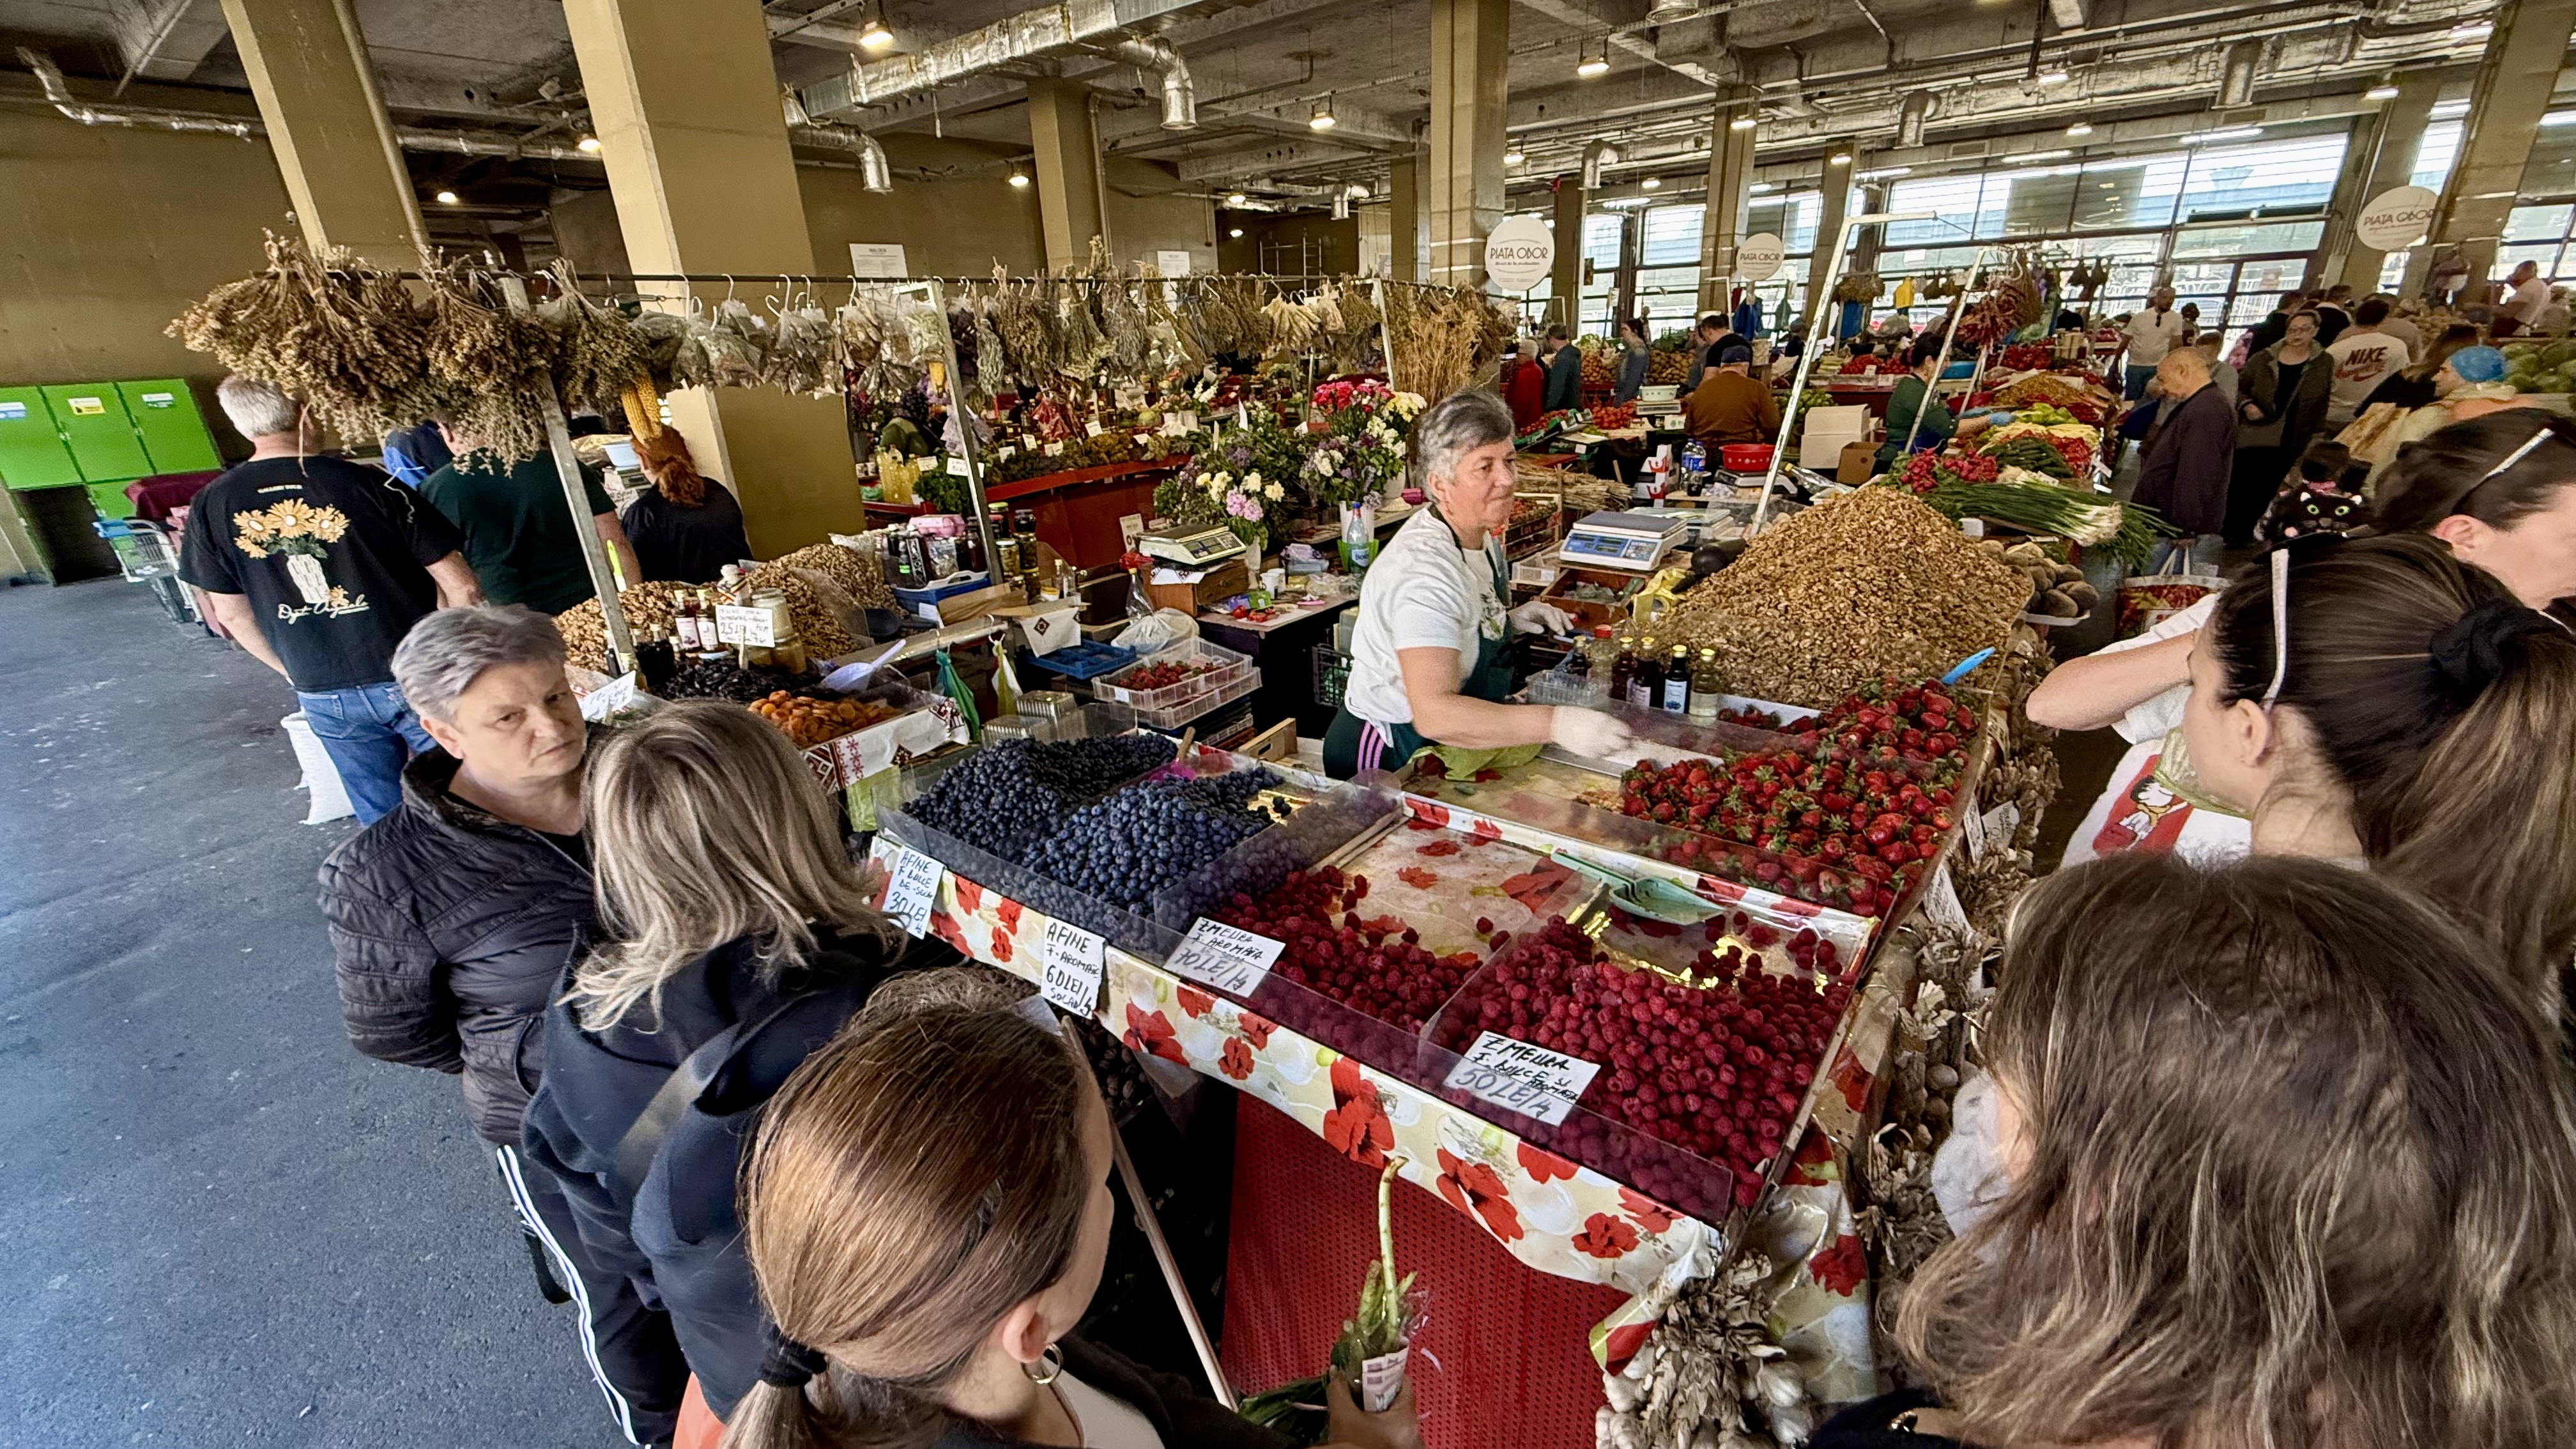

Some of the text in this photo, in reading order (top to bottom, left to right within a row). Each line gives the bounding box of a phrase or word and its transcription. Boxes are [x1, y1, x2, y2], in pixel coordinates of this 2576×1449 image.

[1490, 247, 1548, 259] PIATA OBOR
[2345, 346, 2388, 366] NIKE
[900, 850, 932, 873] AFINE
[1046, 922, 1091, 954] AFINE
[1198, 918, 1253, 942] ZMEURA
[1482, 1034, 1570, 1071] ZMEURA
